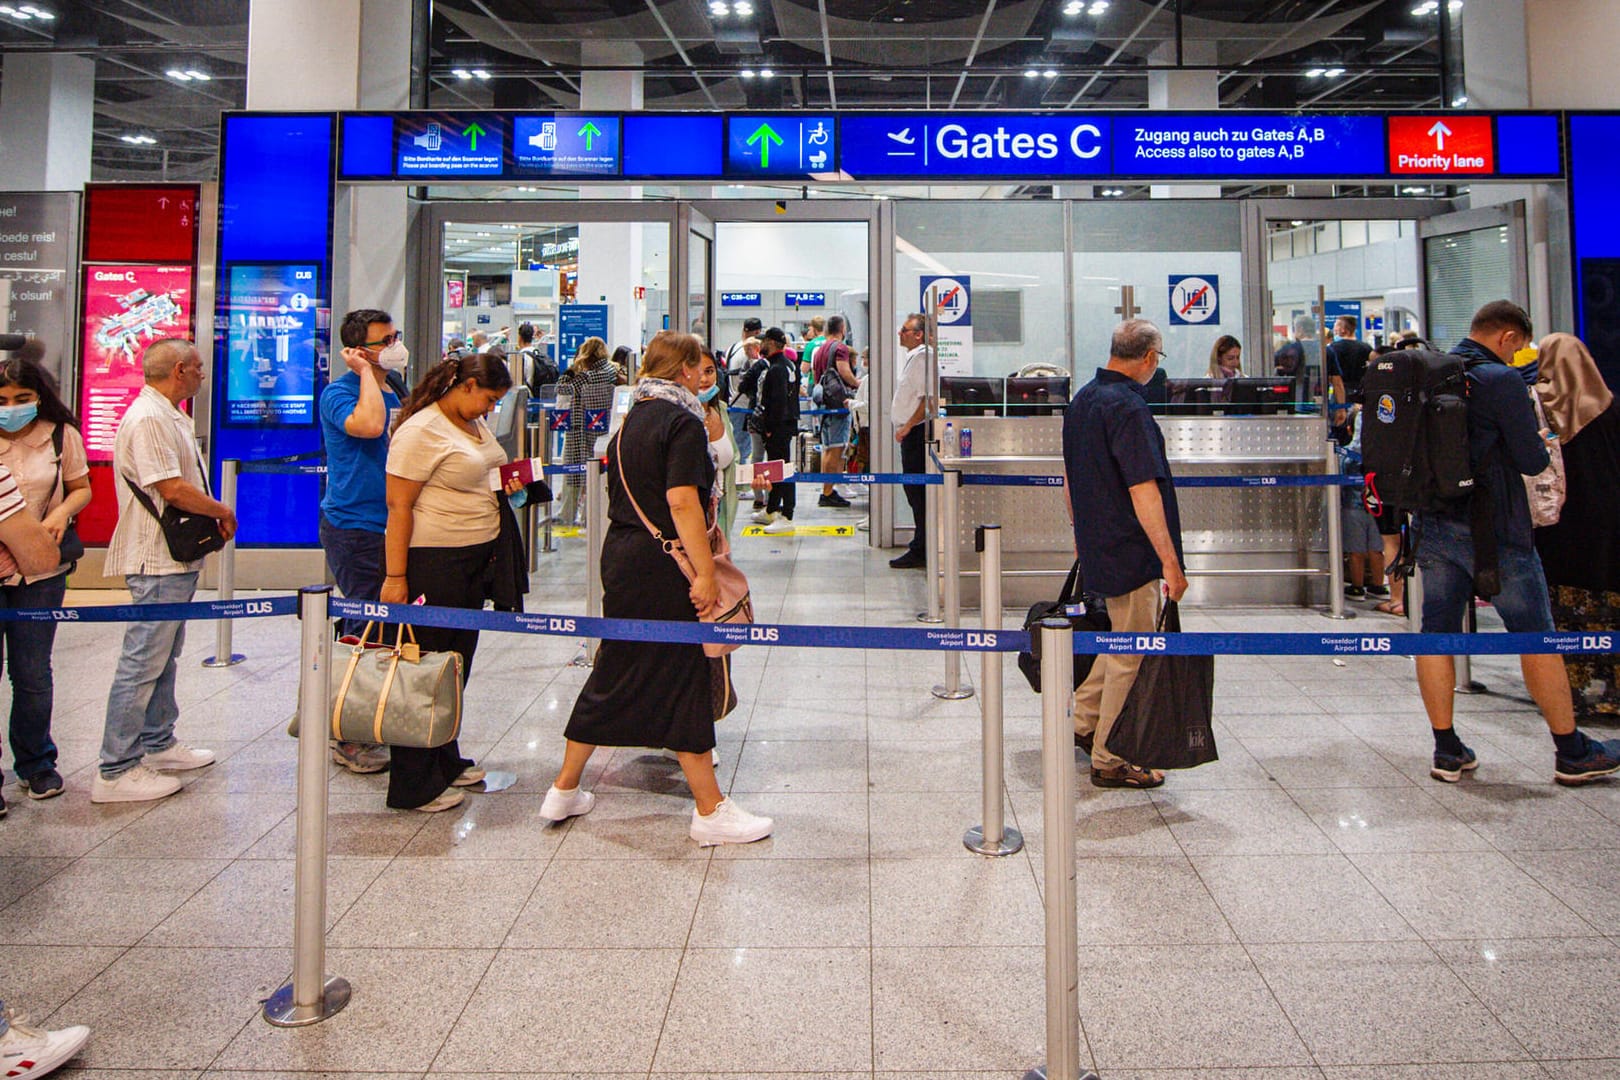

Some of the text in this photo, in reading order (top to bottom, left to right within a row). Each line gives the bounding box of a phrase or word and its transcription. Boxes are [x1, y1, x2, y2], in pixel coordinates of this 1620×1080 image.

[1134, 128, 1325, 144] Zugang auch zu Gates A,B
[936, 124, 1101, 159] Gates C
[1135, 145, 1305, 162] Access also to gates A,B
[1398, 153, 1485, 171] Priority lane
[31, 231, 56, 243] reis!
[94, 271, 124, 281] Gates
[295, 271, 313, 280] DUS
[1047, 477, 1064, 485] DUS
[1261, 477, 1277, 485] DUS
[211, 603, 244, 611] Düsseldorf
[246, 601, 273, 613] DUS
[332, 600, 362, 609] Düsseldorf
[223, 608, 244, 616] Airport
[342, 608, 362, 616] Airport
[364, 603, 389, 617] DUS
[52, 610, 80, 620] DUS
[515, 615, 548, 624] Düsseldorf
[526, 623, 548, 631] Airport
[549, 618, 576, 632] DUS
[713, 626, 748, 634] Düsseldorf
[750, 628, 779, 641] DUS
[725, 632, 748, 641] Airport
[927, 631, 964, 640] Düsseldorf
[966, 633, 997, 647] DUS
[1096, 636, 1133, 644] Düsseldorf
[1543, 636, 1580, 644] Düsseldorf
[939, 638, 964, 647] Airport
[1135, 637, 1167, 650] DUS
[1321, 637, 1358, 645] Düsseldorf
[1360, 637, 1391, 651] DUS
[1582, 636, 1612, 650] DUS
[1108, 643, 1133, 651] Airport
[1333, 644, 1358, 652] Airport
[1555, 643, 1580, 651] Airport
